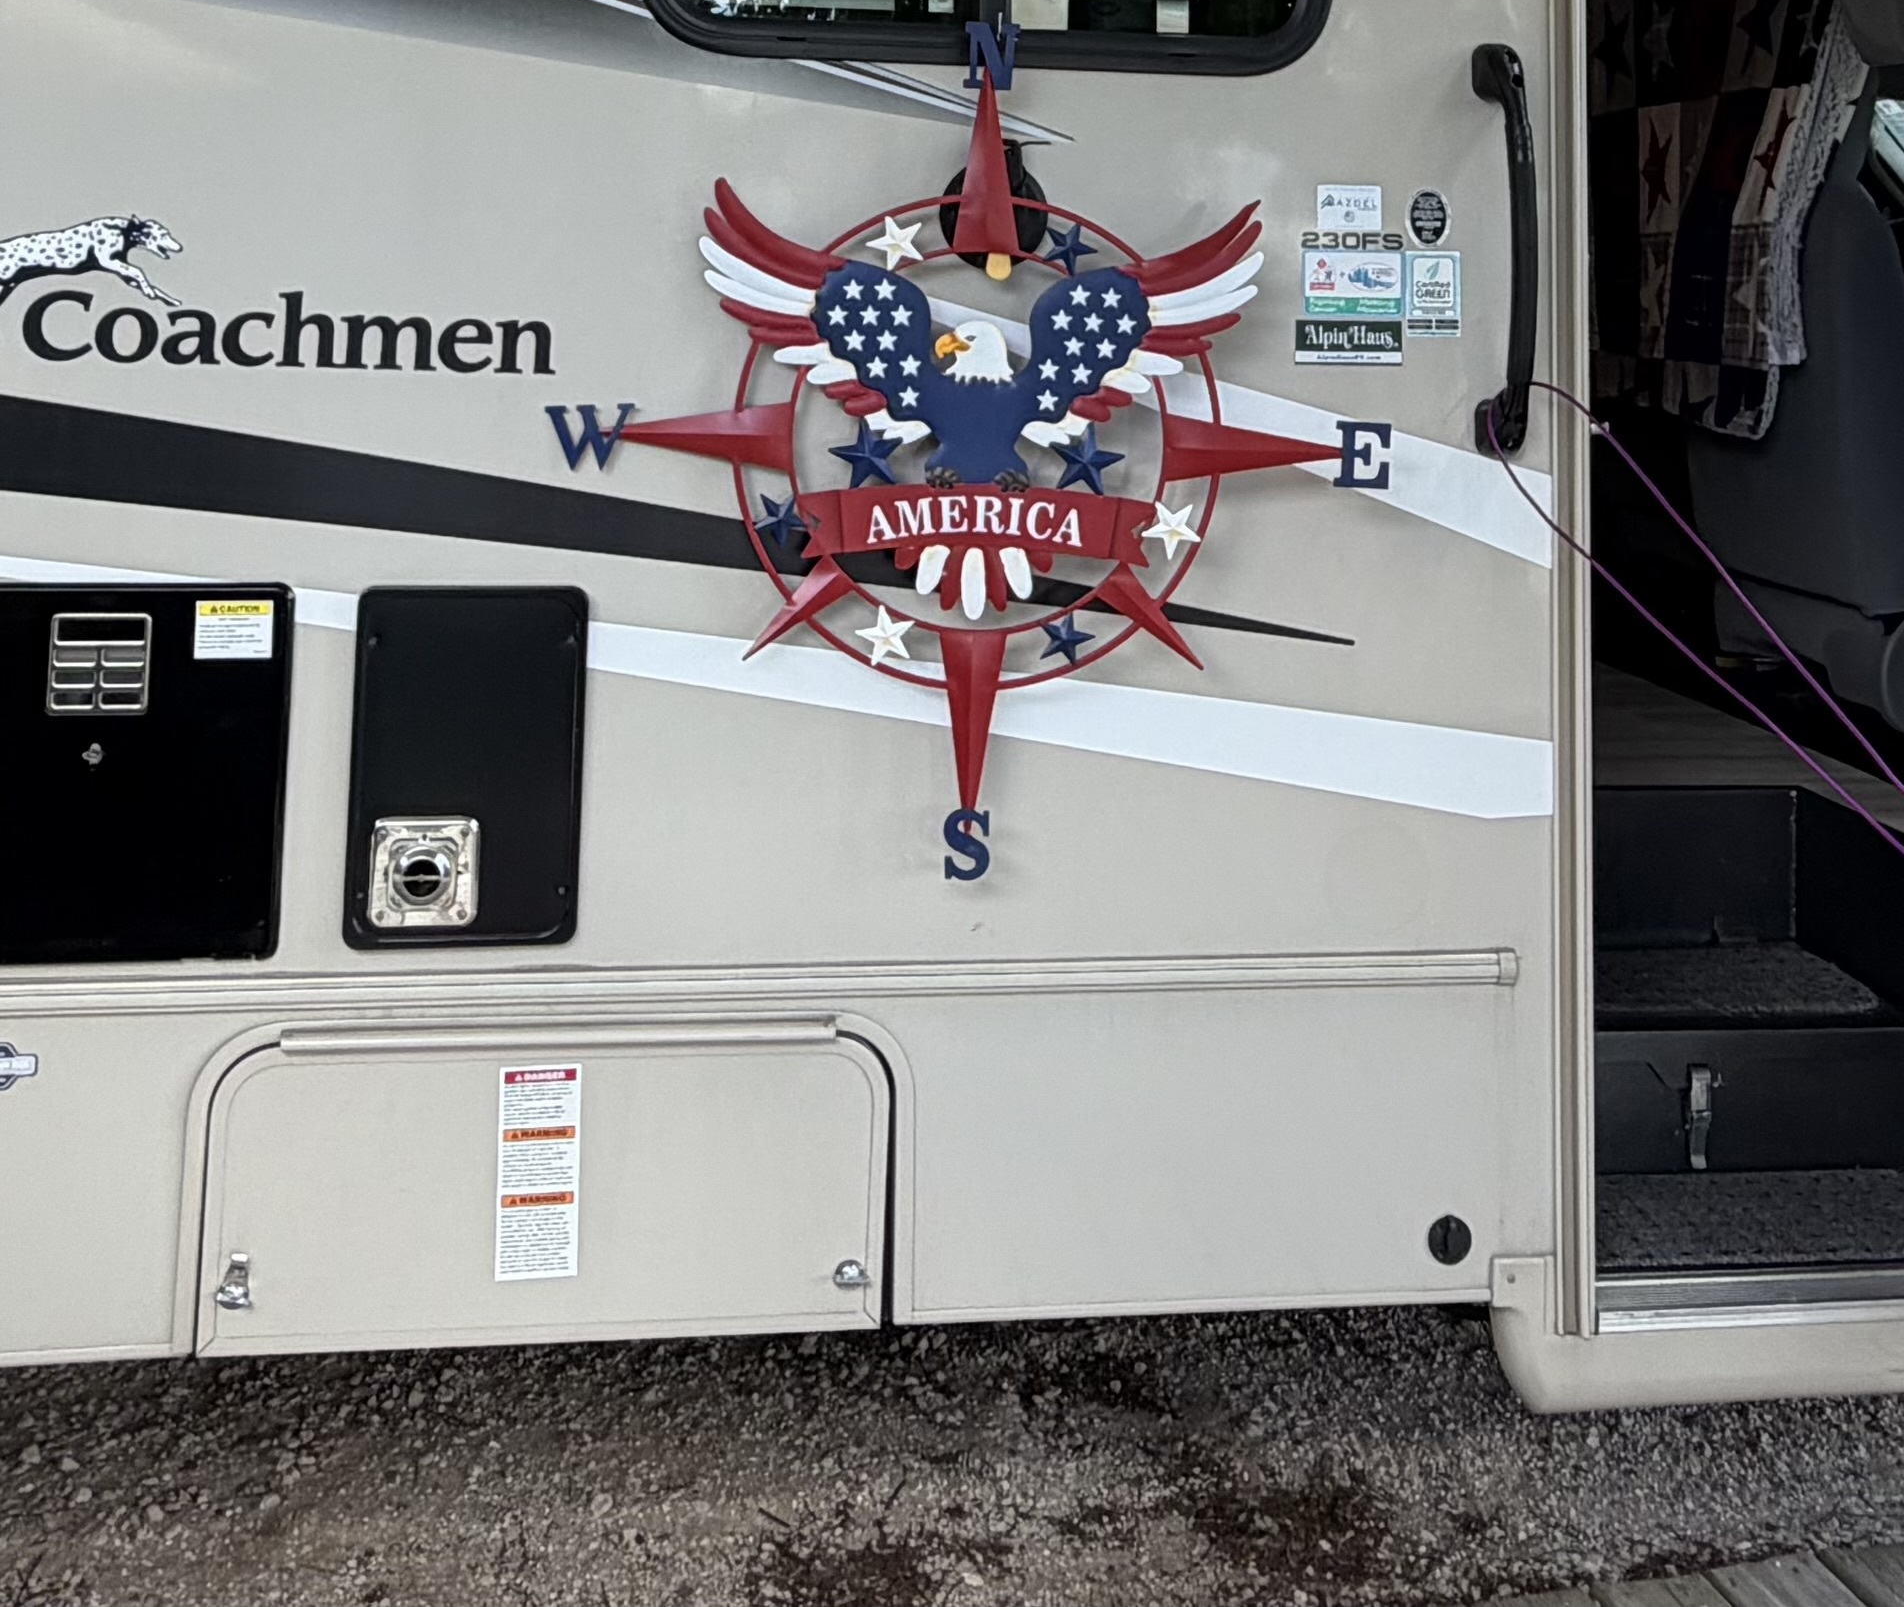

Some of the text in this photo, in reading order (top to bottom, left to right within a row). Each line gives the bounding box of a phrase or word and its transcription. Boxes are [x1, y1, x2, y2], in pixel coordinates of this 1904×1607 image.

[964, 22, 1021, 92] N
[1301, 231, 1404, 251] 230FS
[21, 290, 556, 375] Coachmen
[1304, 324, 1352, 350] Alpin
[545, 403, 635, 472] W
[1333, 421, 1393, 490] E
[864, 495, 1085, 550] AMERICA
[219, 604, 260, 613] CAUTION
[943, 808, 992, 883] S
[523, 1070, 566, 1082] DANGER
[520, 1128, 567, 1139] WARNING
[519, 1194, 567, 1205] WARNING
